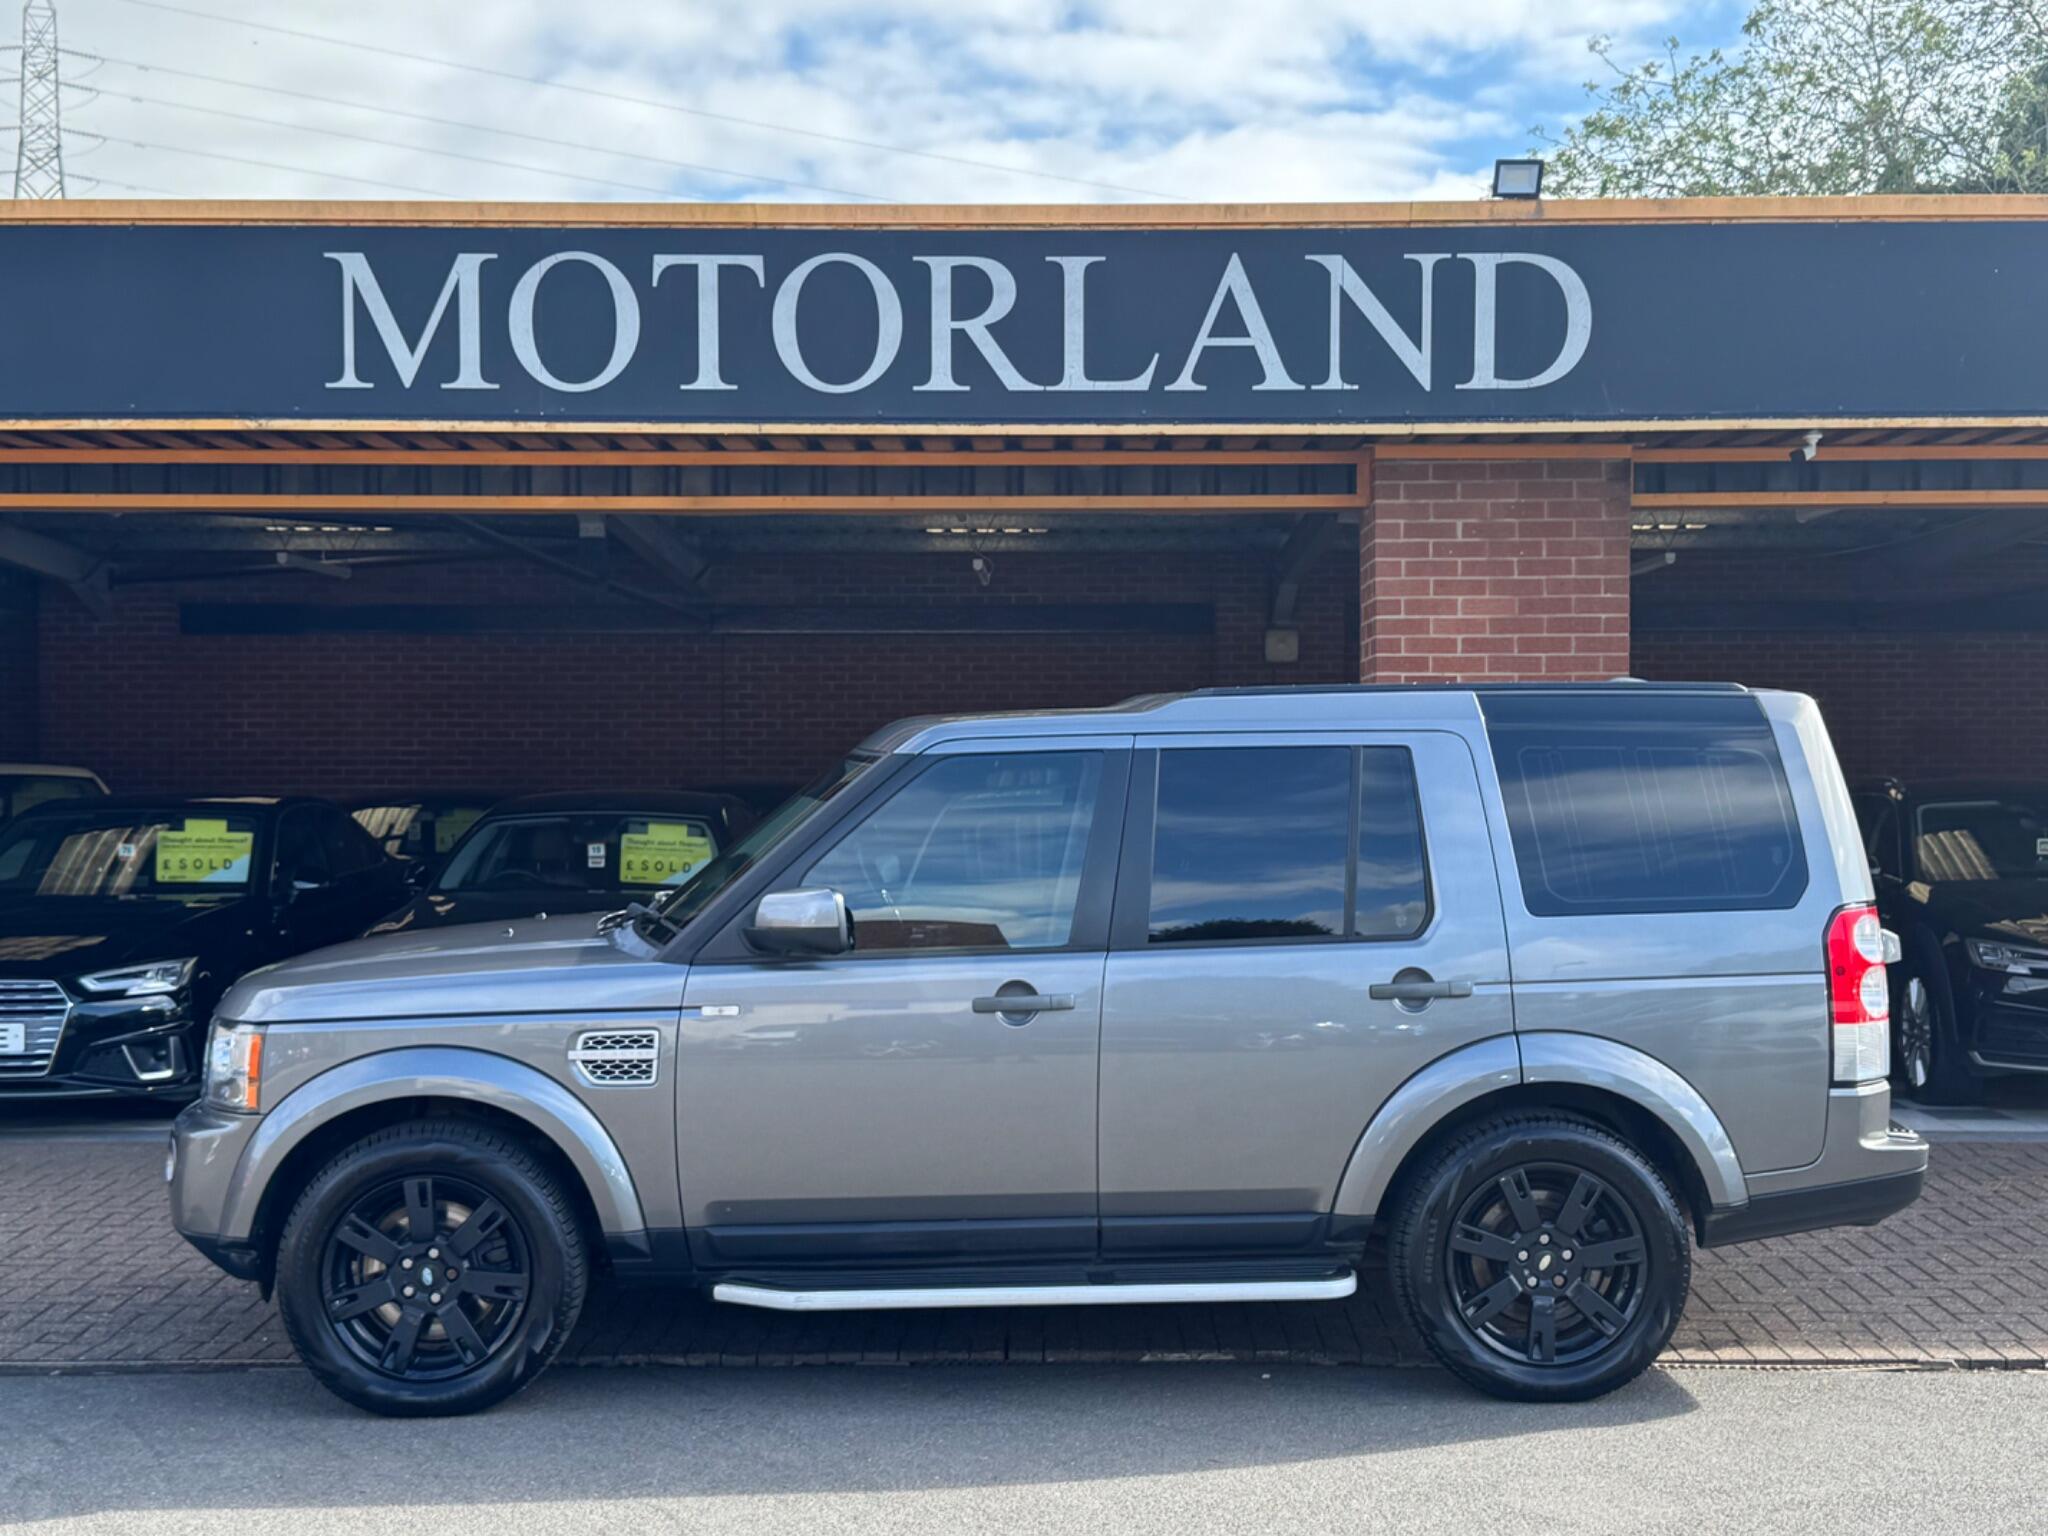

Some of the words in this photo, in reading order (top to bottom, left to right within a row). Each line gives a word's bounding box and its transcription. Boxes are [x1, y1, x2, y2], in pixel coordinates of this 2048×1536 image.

[324, 251, 1593, 394] MOTORLAND
[179, 858, 232, 870] SOLD
[641, 860, 692, 873] SOLD
